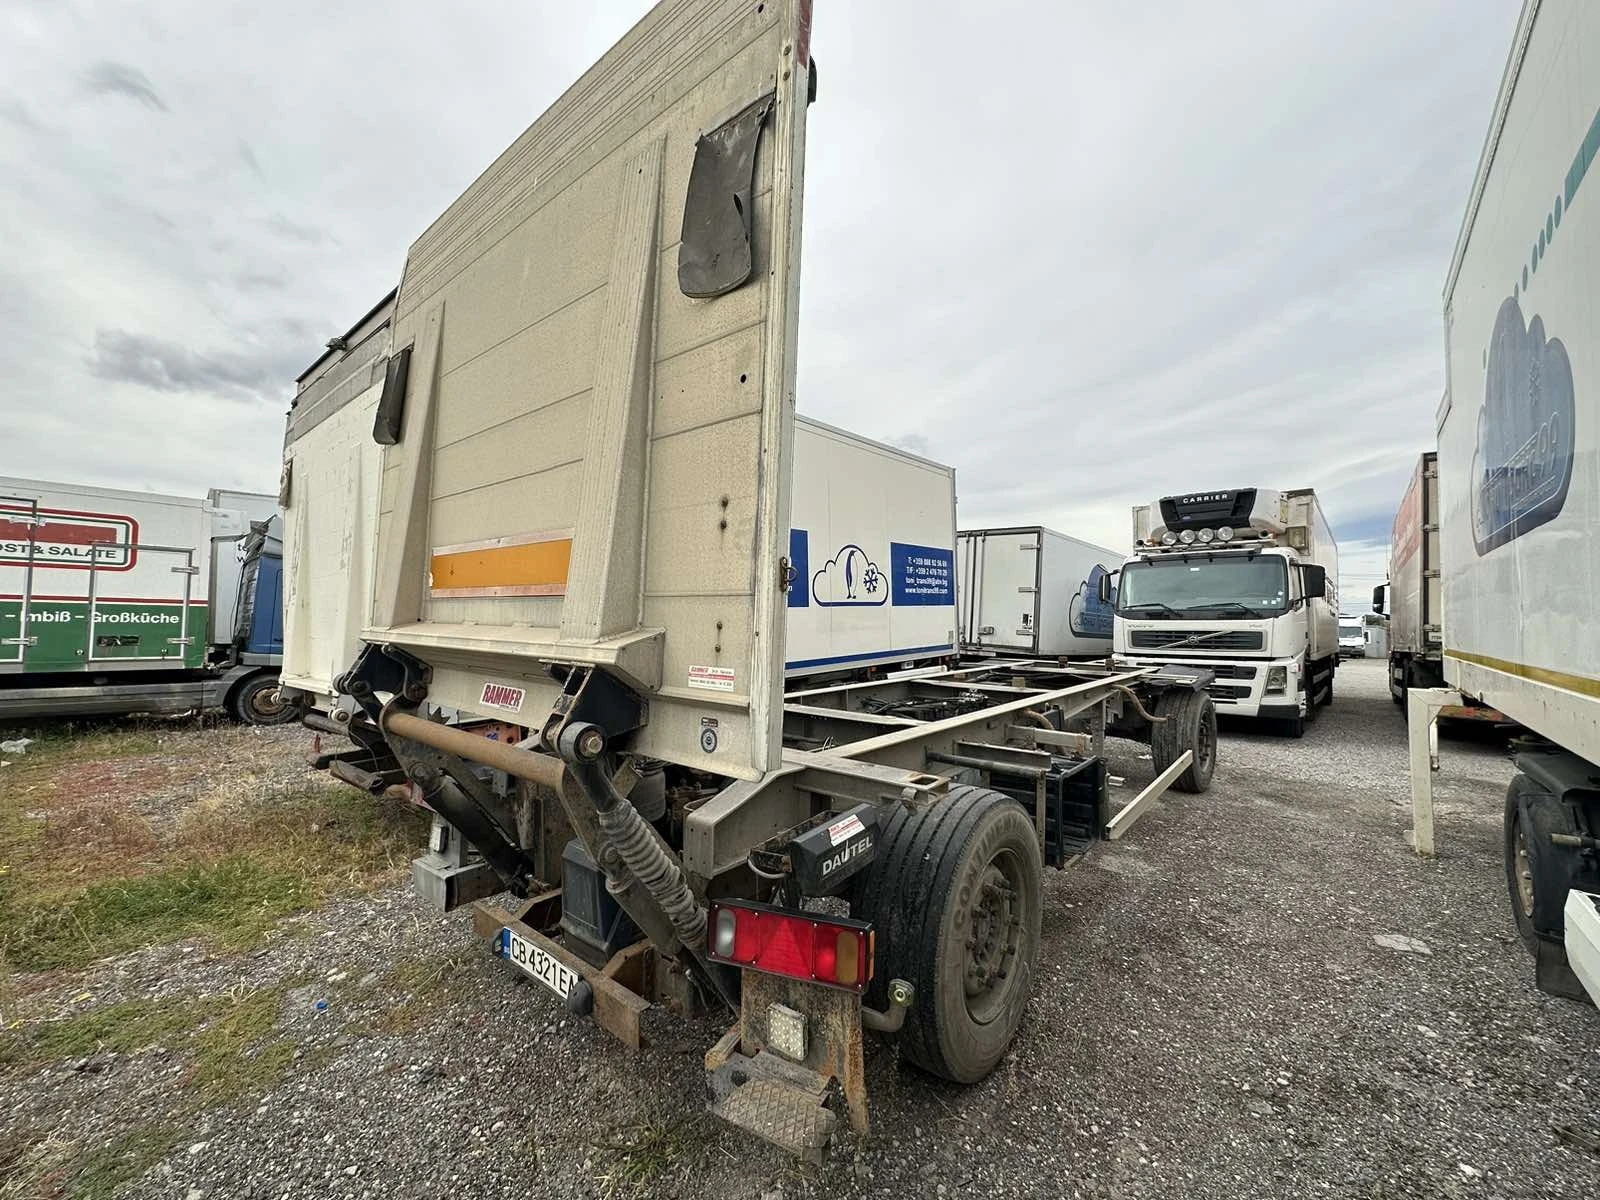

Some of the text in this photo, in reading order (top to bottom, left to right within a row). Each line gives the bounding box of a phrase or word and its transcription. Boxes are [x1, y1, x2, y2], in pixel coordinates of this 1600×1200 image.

[1183, 494, 1228, 504] CARRIER
[0, 542, 29, 553] ST
[48, 546, 117, 559] SALATE
[91, 611, 180, 625] Großküche
[822, 836, 873, 877] DAUTEL
